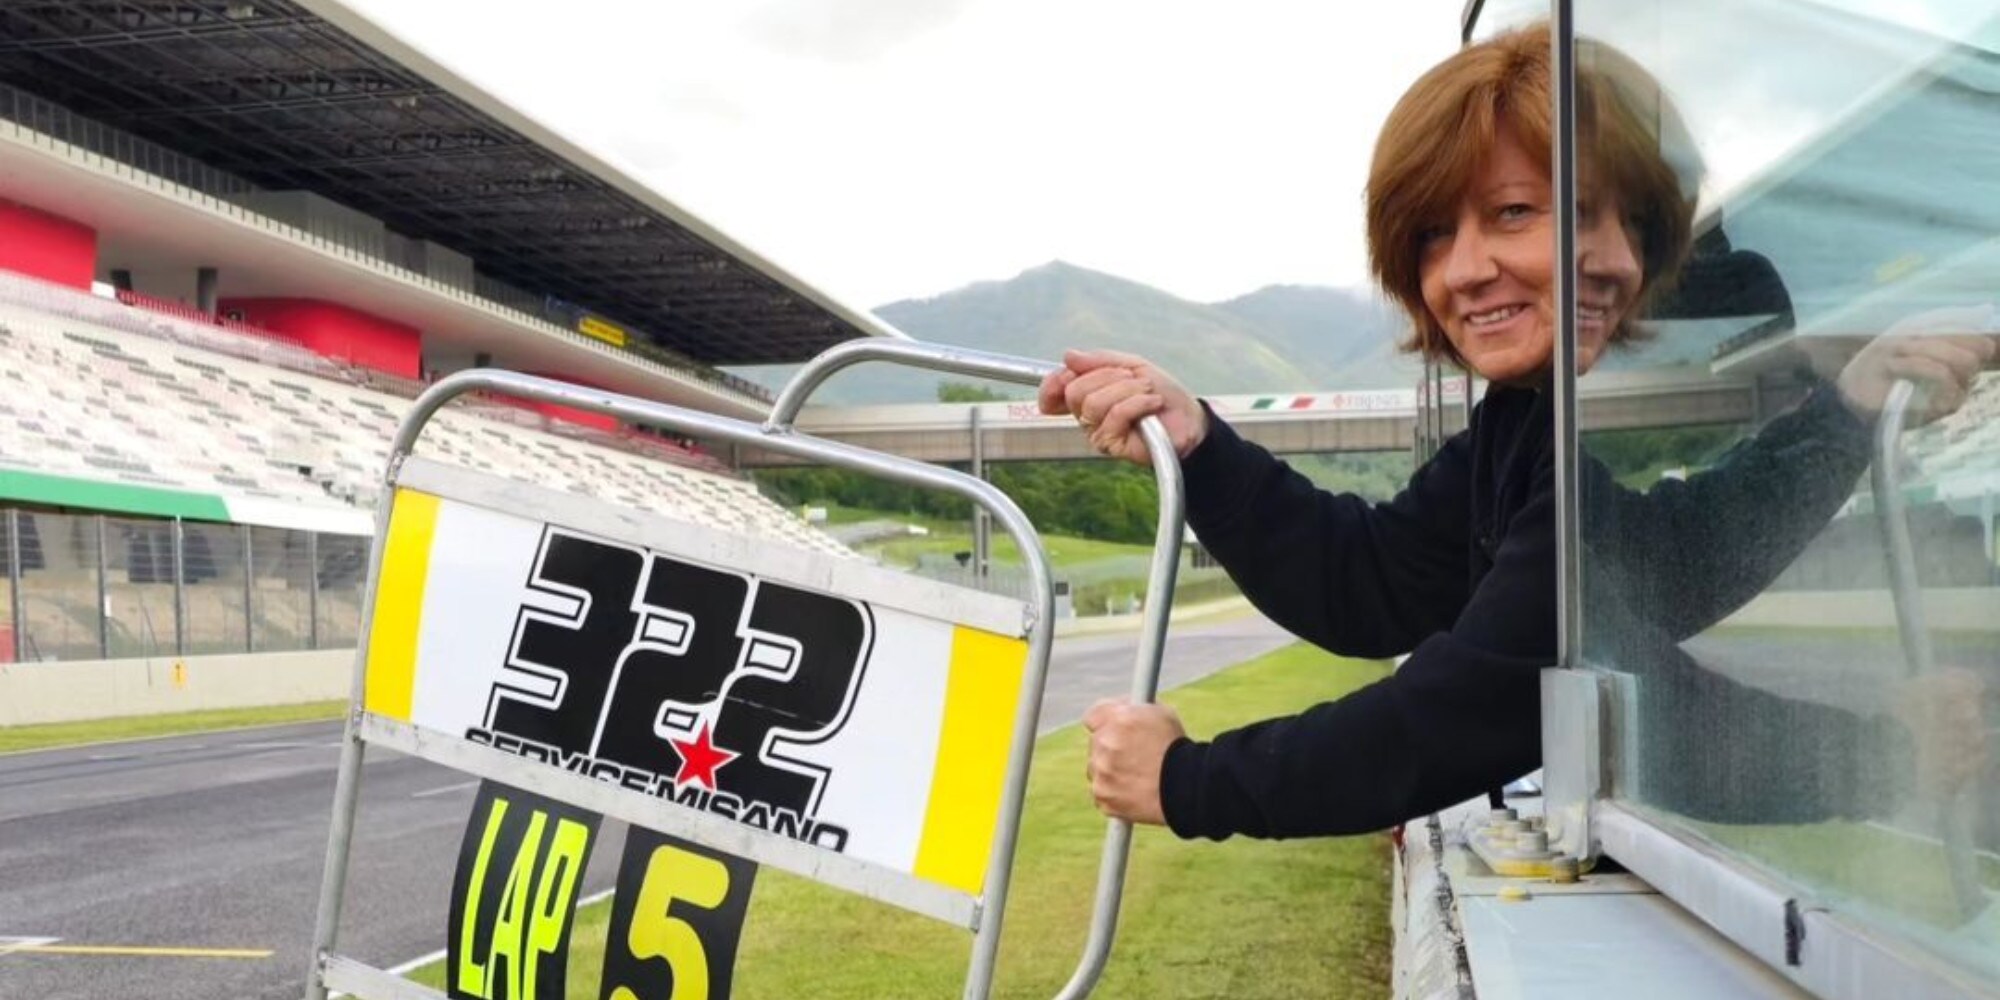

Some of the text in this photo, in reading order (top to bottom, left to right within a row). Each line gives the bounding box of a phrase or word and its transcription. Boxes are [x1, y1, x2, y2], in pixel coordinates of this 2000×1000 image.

[484, 523, 876, 818] 322
[458, 798, 730, 1000] LAP 5
